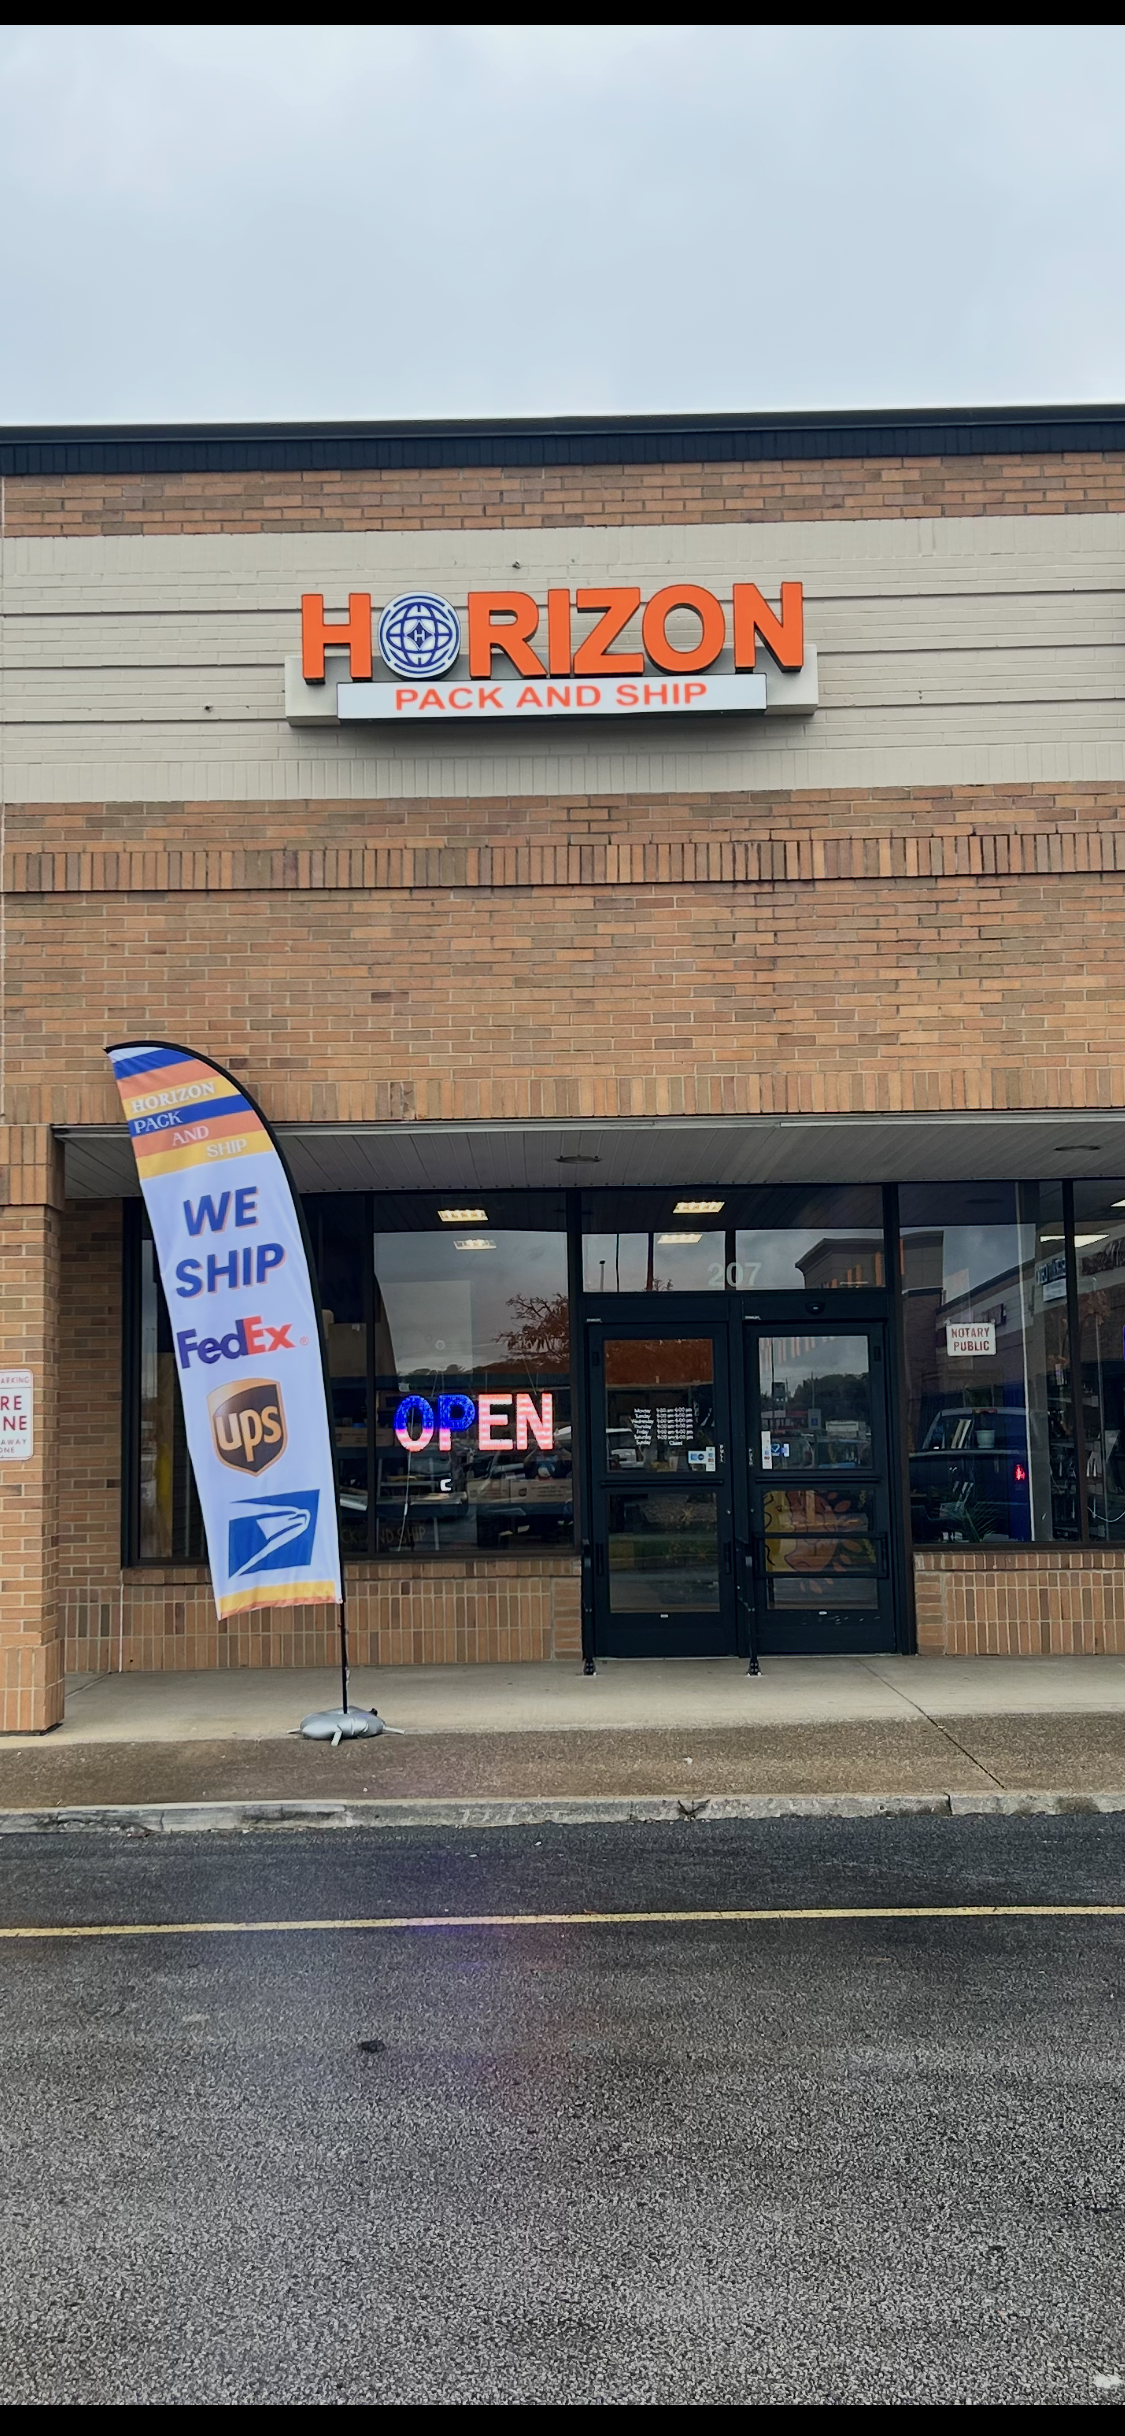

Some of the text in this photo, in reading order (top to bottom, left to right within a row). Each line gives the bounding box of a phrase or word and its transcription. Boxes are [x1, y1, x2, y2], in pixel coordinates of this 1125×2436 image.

[301, 581, 804, 682] HORIZON
[395, 682, 707, 711] PACK AND SHIP
[130, 1081, 215, 1113] HORIZON
[134, 1111, 183, 1134] PACK
[172, 1125, 210, 1147] AND
[206, 1138, 248, 1158] SHIP
[183, 1186, 259, 1238] WE
[175, 1243, 286, 1299] SHIP
[707, 1262, 762, 1287] 207
[176, 1316, 297, 1369] FedEx
[951, 1327, 990, 1339] NOTARY
[953, 1341, 990, 1352] PUBLIC
[0, 1376, 30, 1384] ARKING
[0, 1395, 22, 1411] RE
[3, 1415, 27, 1431] NE
[215, 1405, 283, 1463] ups
[394, 1393, 554, 1452] OPEN
